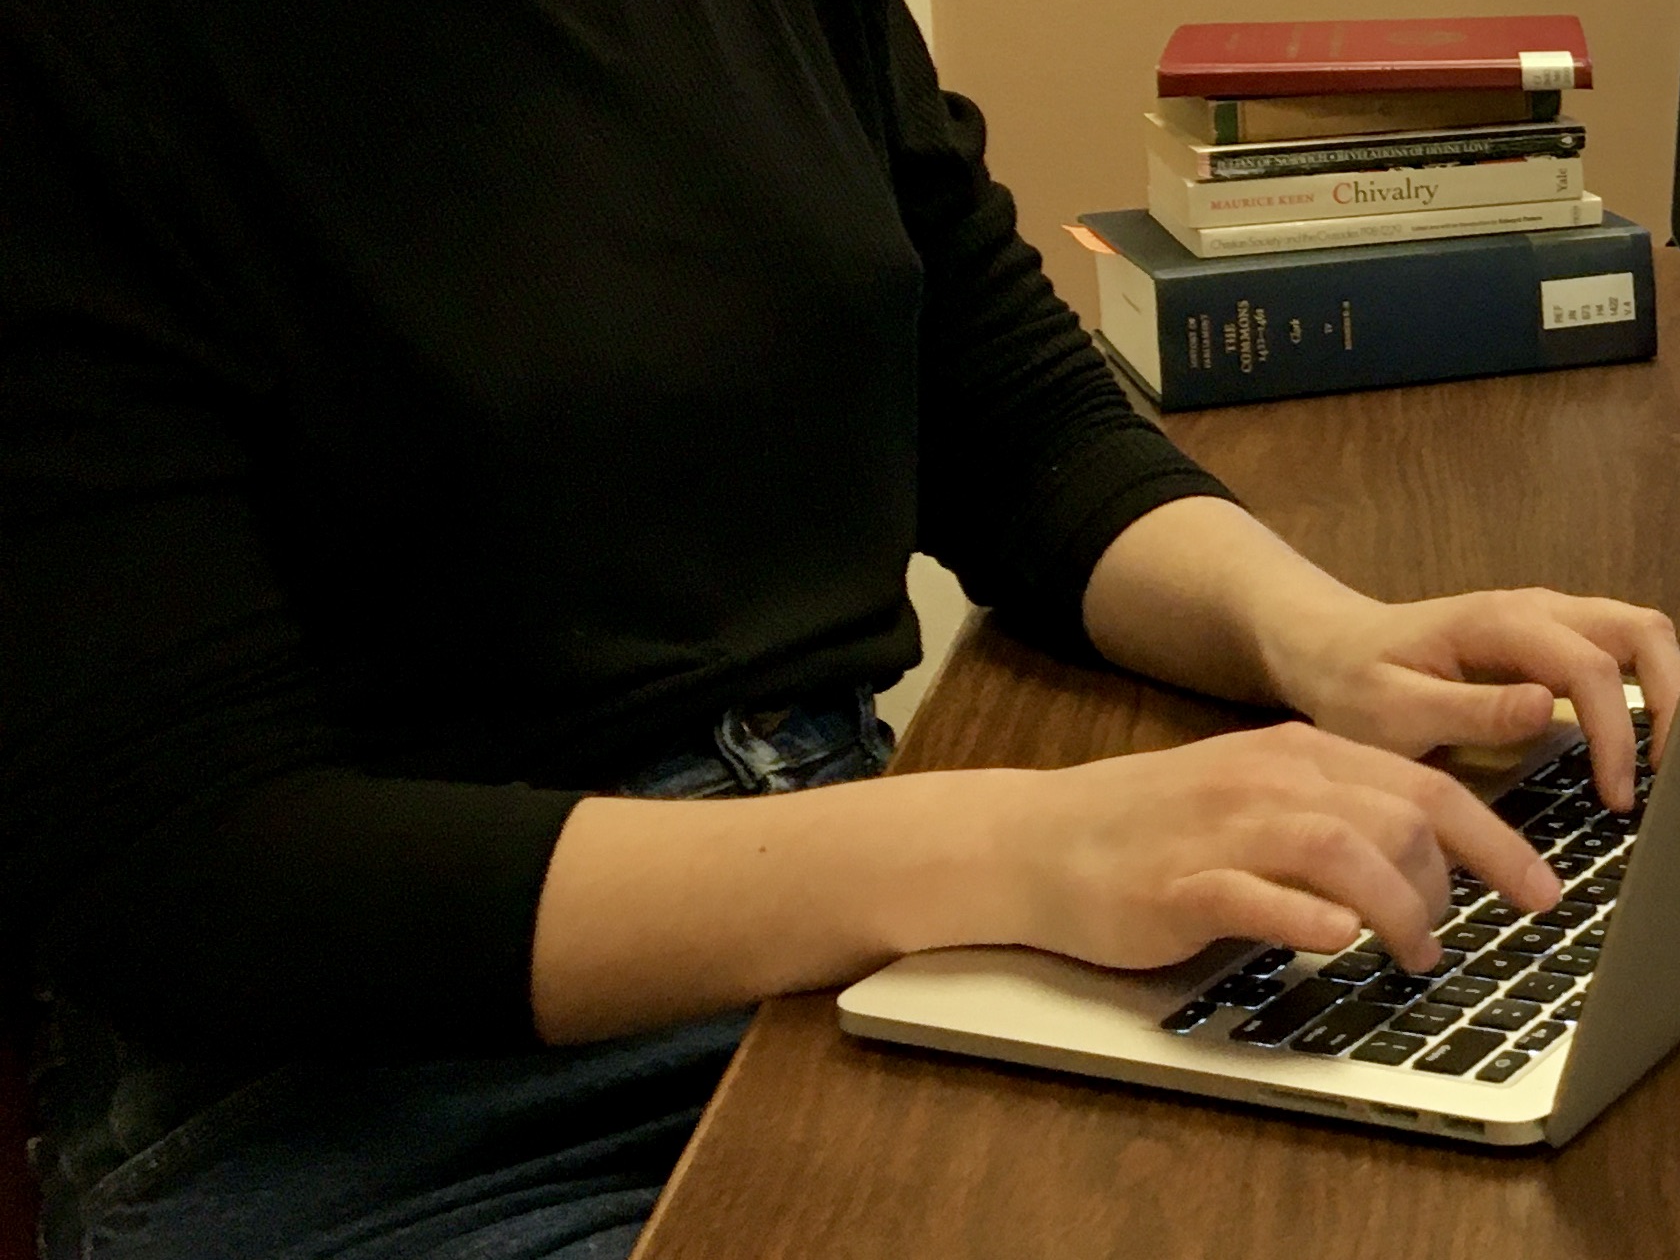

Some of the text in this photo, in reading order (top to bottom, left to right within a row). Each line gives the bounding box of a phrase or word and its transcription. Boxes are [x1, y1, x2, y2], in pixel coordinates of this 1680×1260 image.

[1257, 155, 1270, 168] OF
[1338, 144, 1410, 162] REVELATIONS
[1411, 143, 1425, 157] OF
[1426, 142, 1462, 156] DIVINE
[1463, 141, 1491, 154] LOVE
[1332, 176, 1439, 206] Chivalry
[1556, 167, 1568, 193] Yale
[1210, 193, 1315, 210] MAURICE KEEN
[1187, 317, 1197, 330] OF
[1553, 304, 1564, 324] REF
[1223, 322, 1237, 353] THE
[1236, 299, 1252, 373] COMMONS
[1289, 318, 1302, 344] Clark
